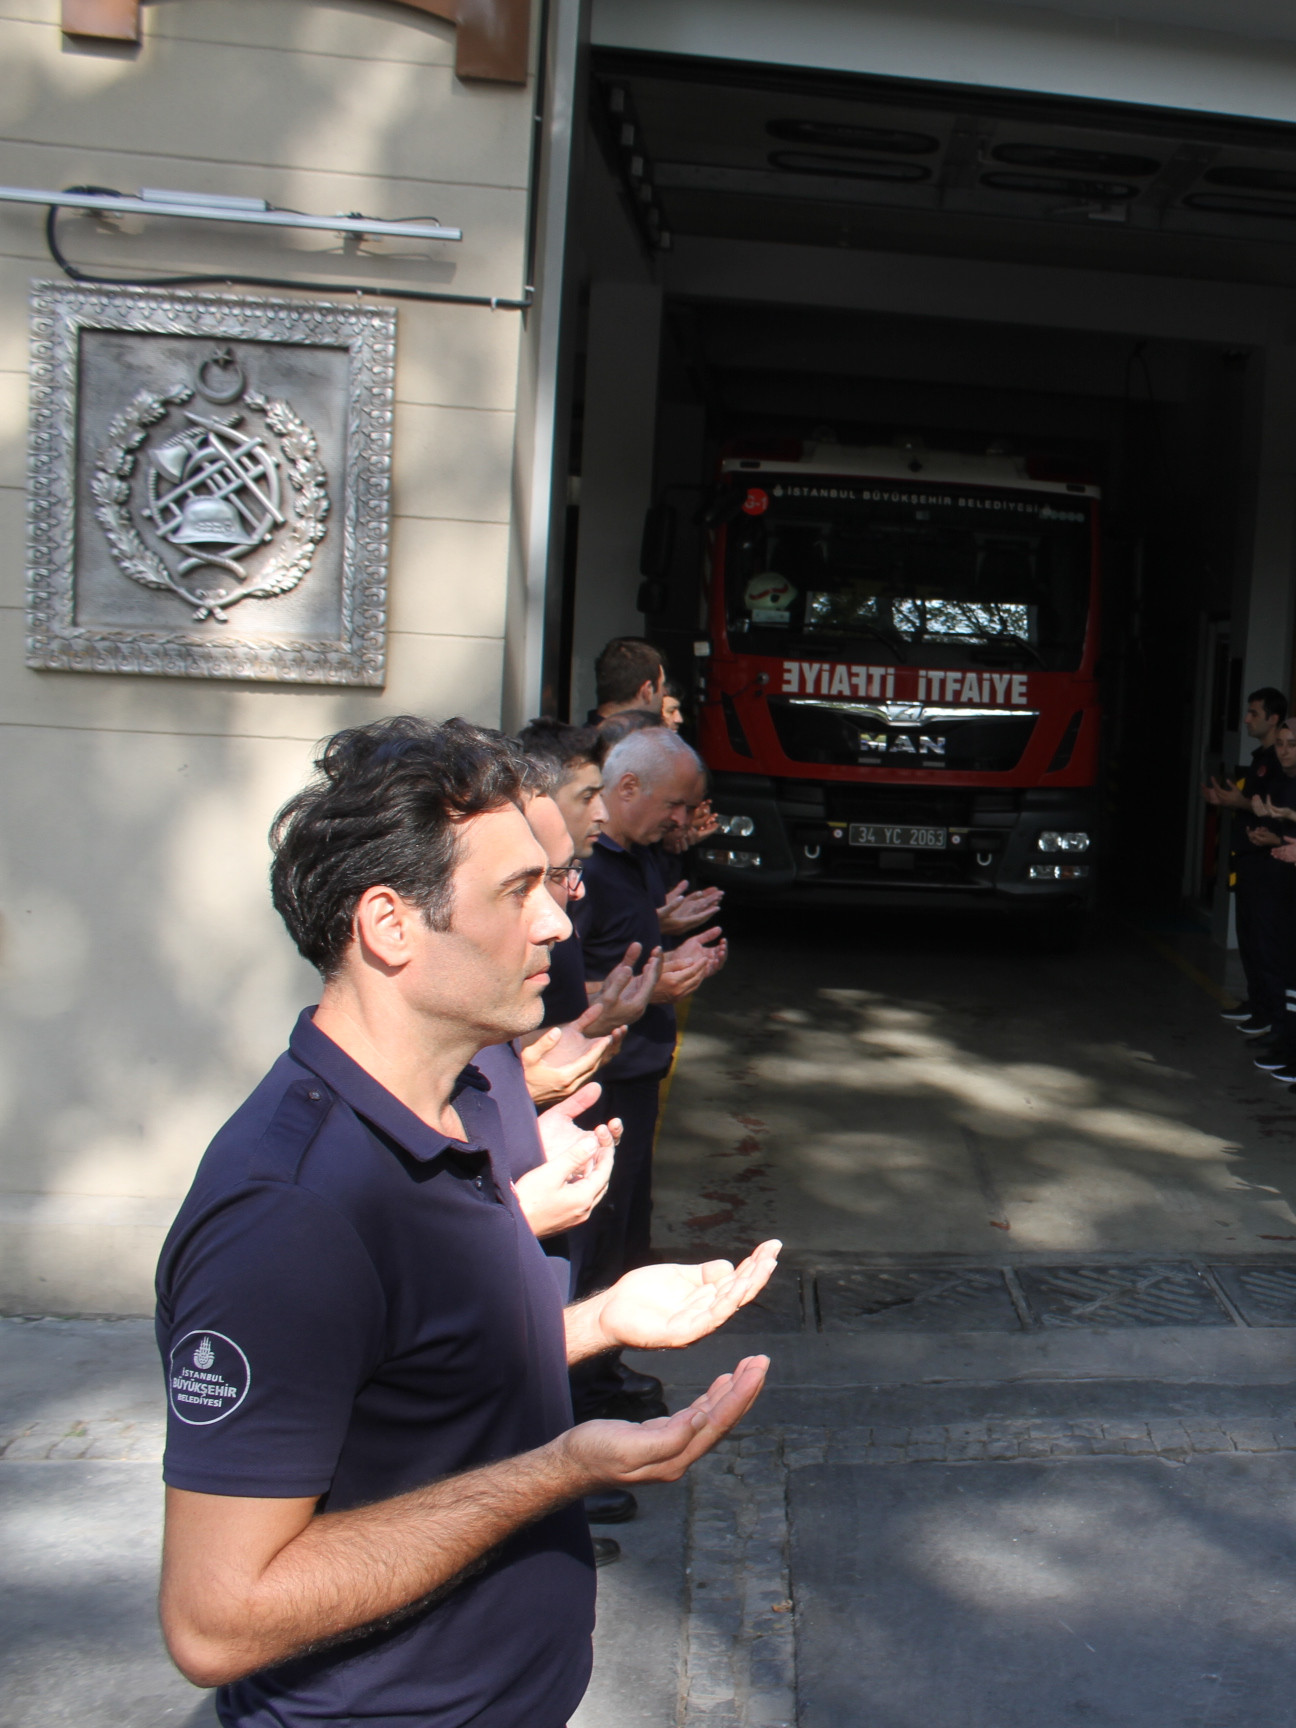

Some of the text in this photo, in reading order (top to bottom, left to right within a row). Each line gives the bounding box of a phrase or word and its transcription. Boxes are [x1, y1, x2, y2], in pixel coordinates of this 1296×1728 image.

[787, 485, 856, 499] İSTANBUL
[859, 733, 946, 755] MAN
[858, 827, 944, 846] 34 YC 2063
[182, 1367, 225, 1383] İSTANBUL
[172, 1376, 238, 1398] BÜYÜKŞEHİR
[177, 1393, 222, 1408] BELEDİYESİ
